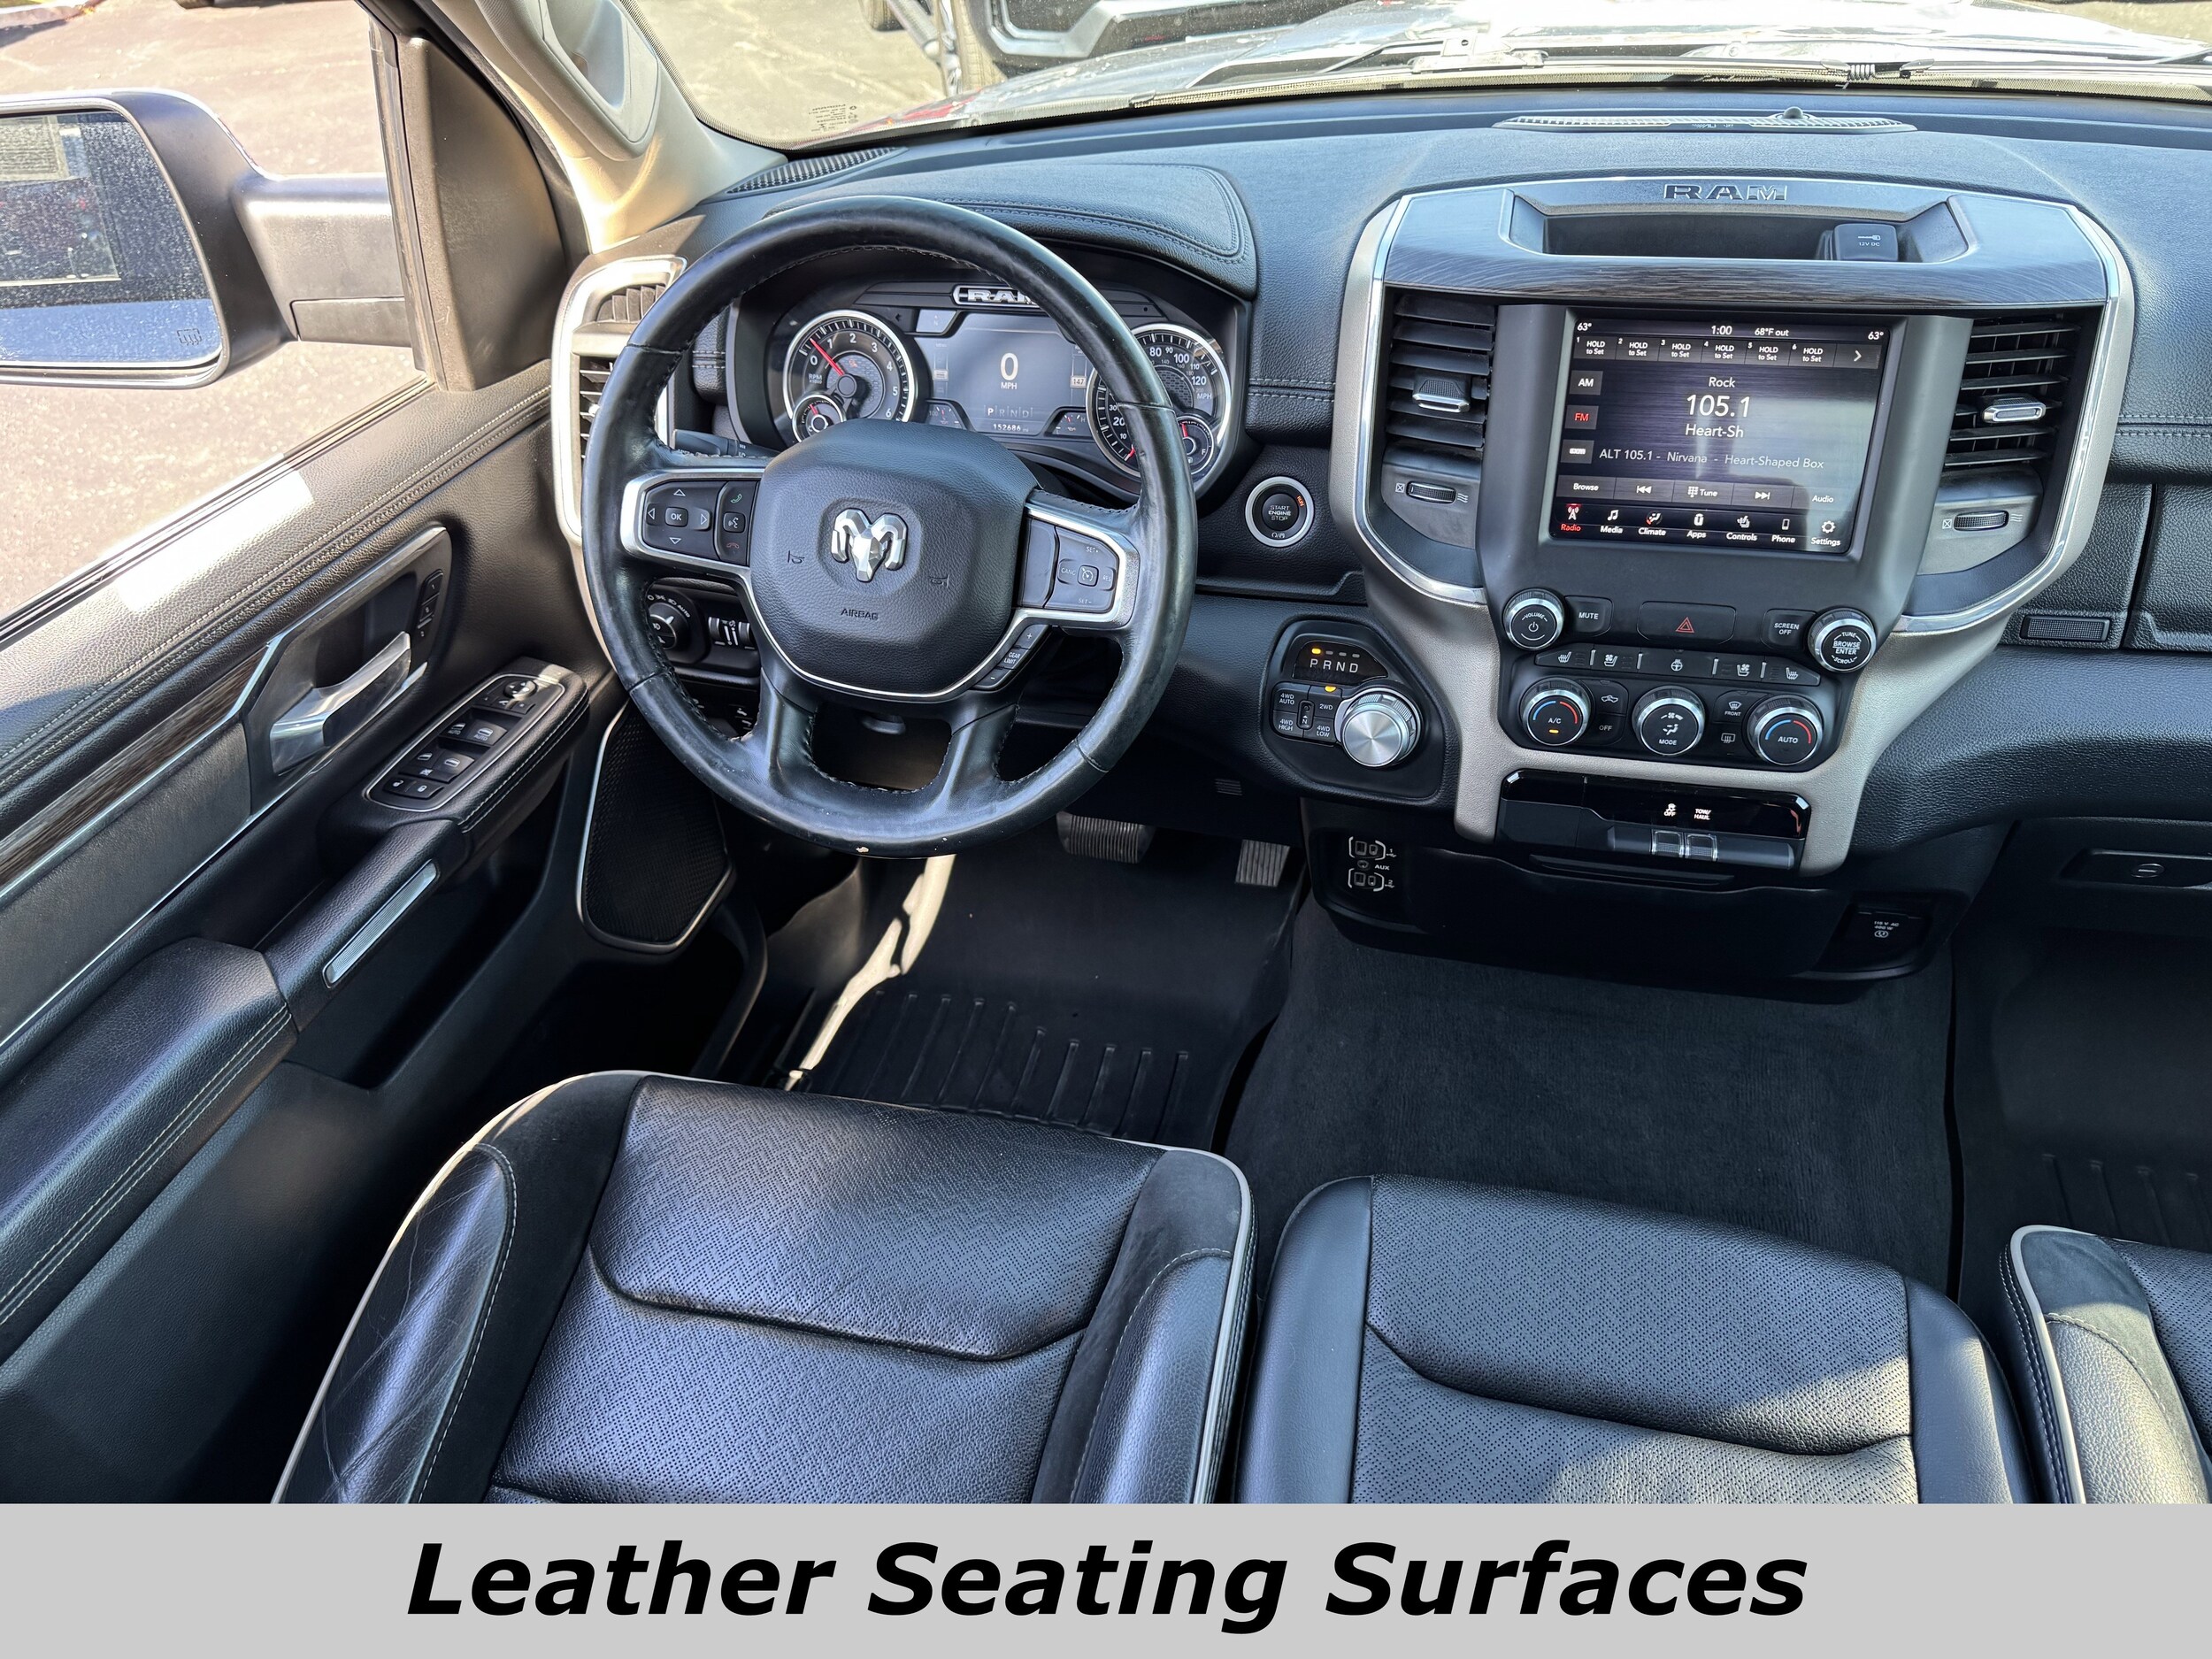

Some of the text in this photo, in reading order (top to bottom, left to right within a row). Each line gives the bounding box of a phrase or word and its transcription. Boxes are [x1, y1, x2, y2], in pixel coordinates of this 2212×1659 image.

[1663, 183, 1787, 201] RAM
[1710, 325, 1732, 335] 1:00
[849, 333, 856, 343] 2
[826, 338, 833, 349] 1
[872, 342, 878, 353] 3
[1149, 347, 1162, 357] 80
[810, 356, 818, 365] 0
[1173, 353, 1190, 364] 100
[887, 361, 893, 372] 4
[1000, 352, 1018, 381] 0
[1191, 376, 1207, 386] 120
[1578, 378, 1594, 388] AM
[1709, 377, 1736, 388] Rock
[893, 386, 898, 396] 5
[1686, 394, 1751, 418] 105.1
[886, 408, 892, 418] 6
[987, 407, 995, 416] P
[1010, 410, 1018, 419] N
[1575, 412, 1589, 421] FM
[1113, 417, 1125, 426] 20
[993, 423, 1021, 432] 152686
[1685, 424, 1744, 438] Heart-Sh
[1599, 449, 1622, 459] ALT
[1624, 449, 1653, 461] 105.1
[1667, 451, 1708, 464] Nirvana
[1724, 454, 1800, 469] Heart-Shaped
[1802, 457, 1824, 469] Box
[1560, 523, 1581, 532] Radio
[1600, 526, 1624, 534] Media
[1638, 527, 1667, 536] Climate
[1686, 530, 1707, 540] Apps
[1726, 532, 1758, 541] Controls
[1771, 534, 1796, 543] Phone
[1810, 537, 1841, 547] Settings
[1061, 567, 1077, 576] CANC
[677, 604, 691, 618] AUTO
[841, 608, 879, 620] AIRBAG
[1310, 658, 1358, 673] P R N D
